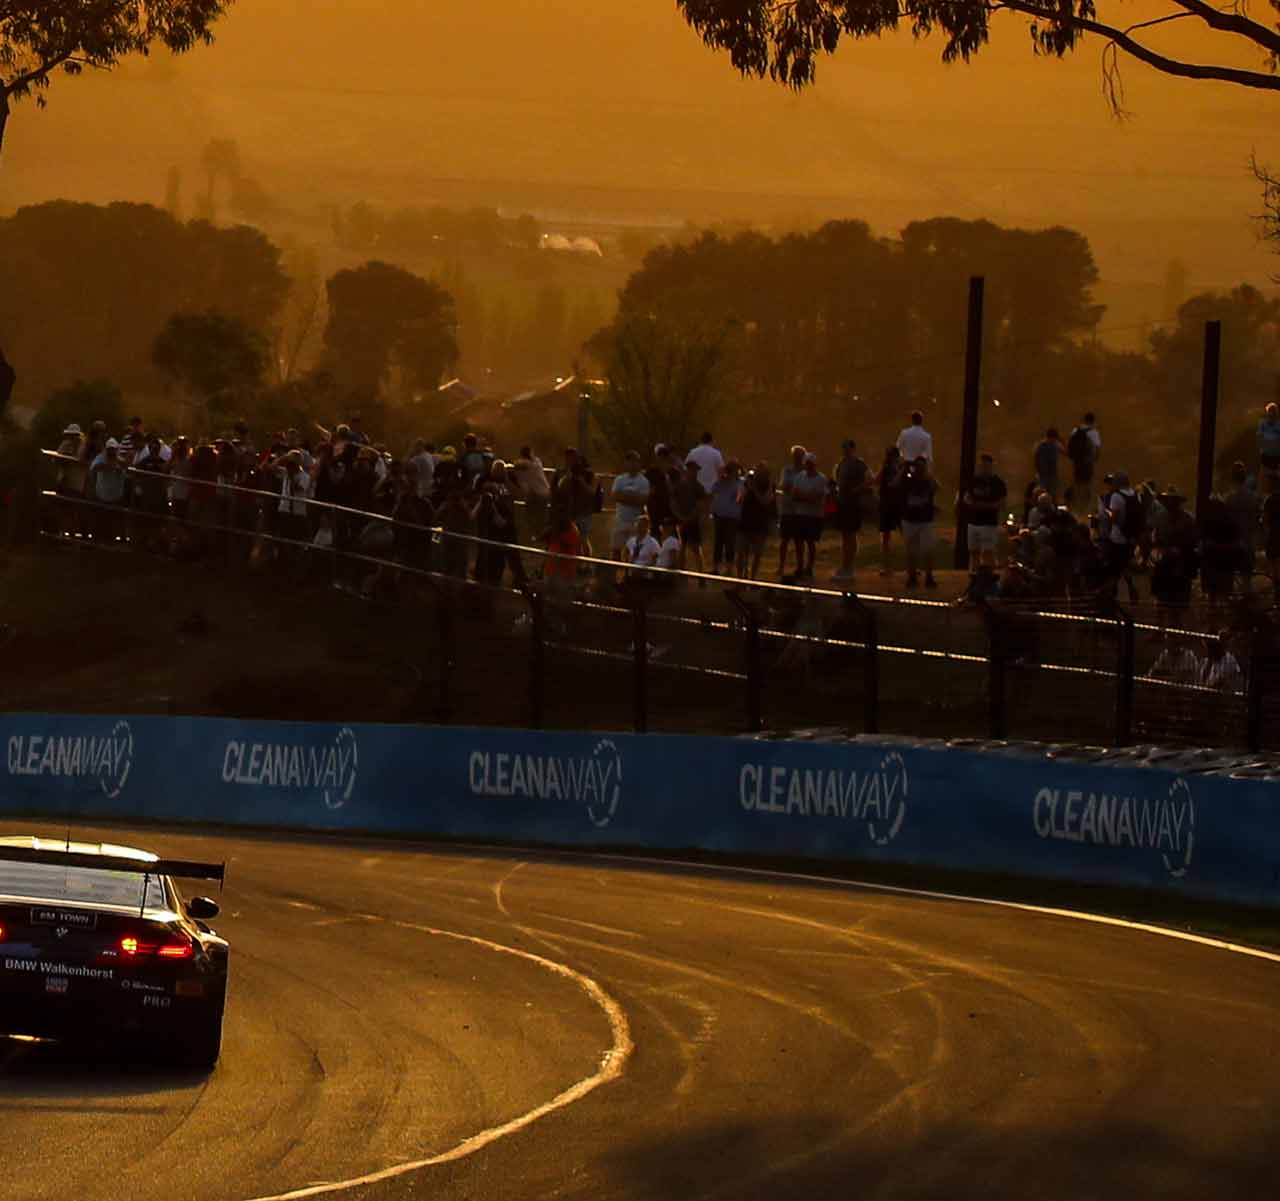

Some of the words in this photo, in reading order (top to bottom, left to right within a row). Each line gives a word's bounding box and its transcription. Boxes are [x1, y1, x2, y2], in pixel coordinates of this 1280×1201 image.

[7, 735, 126, 777] CLEANAWAY
[222, 740, 352, 789] CLEANAWAY
[469, 751, 614, 801] CLEANAWAY
[740, 763, 900, 819] CLEANAWAY
[1033, 787, 1186, 850] CLEANAWAY
[5, 959, 37, 972] BMW
[39, 961, 114, 979] Walkenhorst
